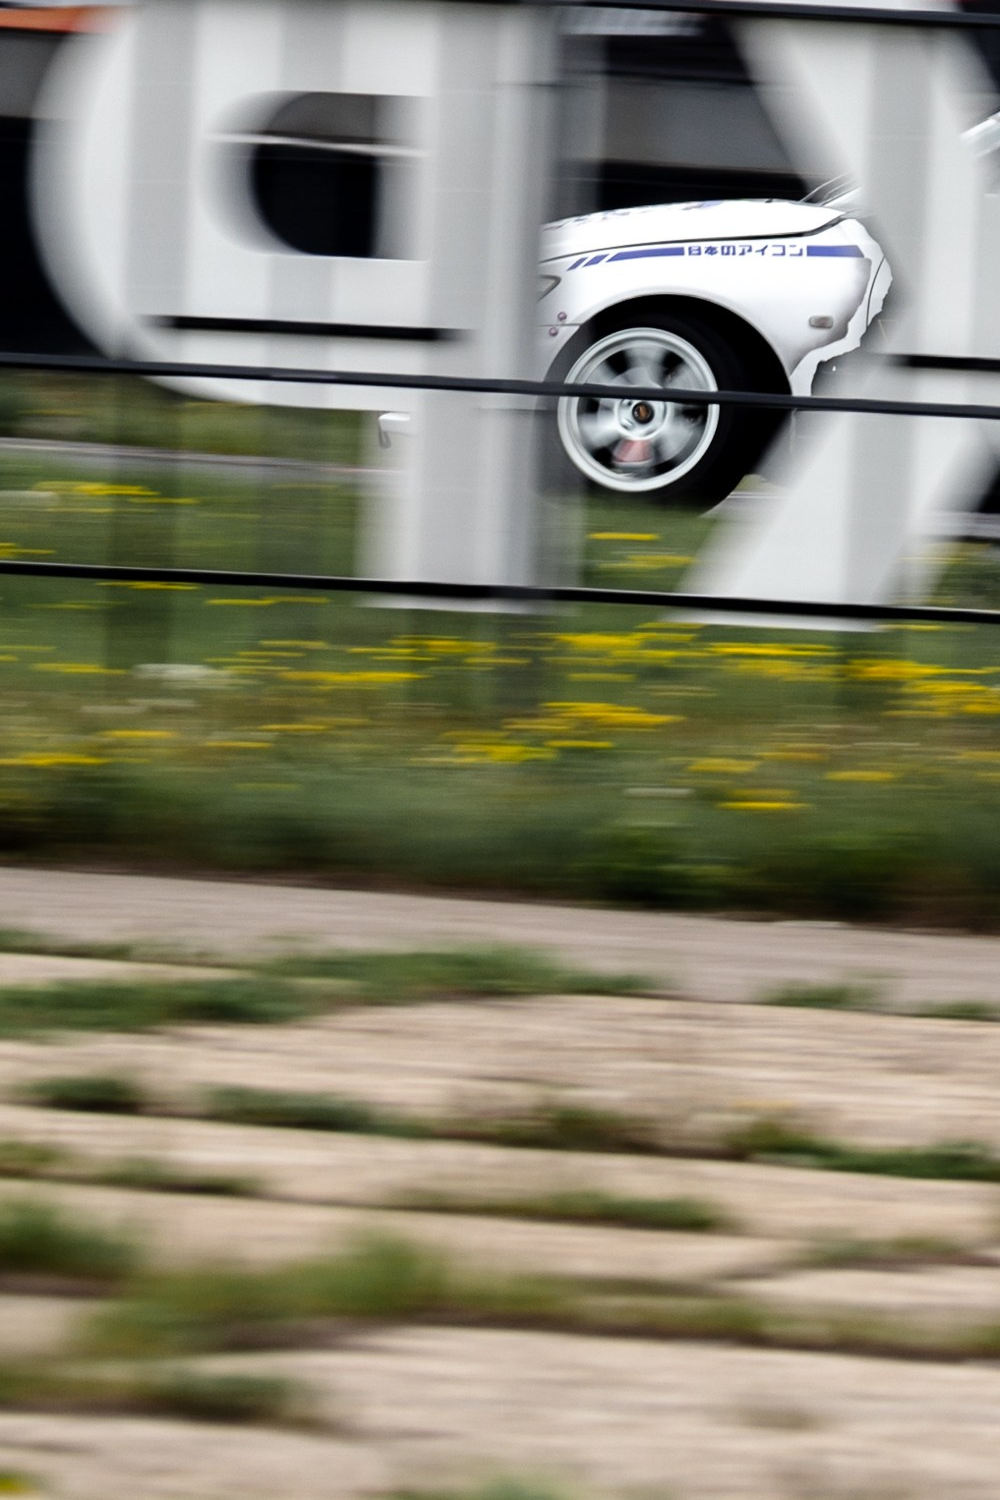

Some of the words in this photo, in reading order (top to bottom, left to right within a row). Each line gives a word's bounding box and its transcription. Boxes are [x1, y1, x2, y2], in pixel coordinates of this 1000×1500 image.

[687, 244, 804, 257] 日本のアイコン
